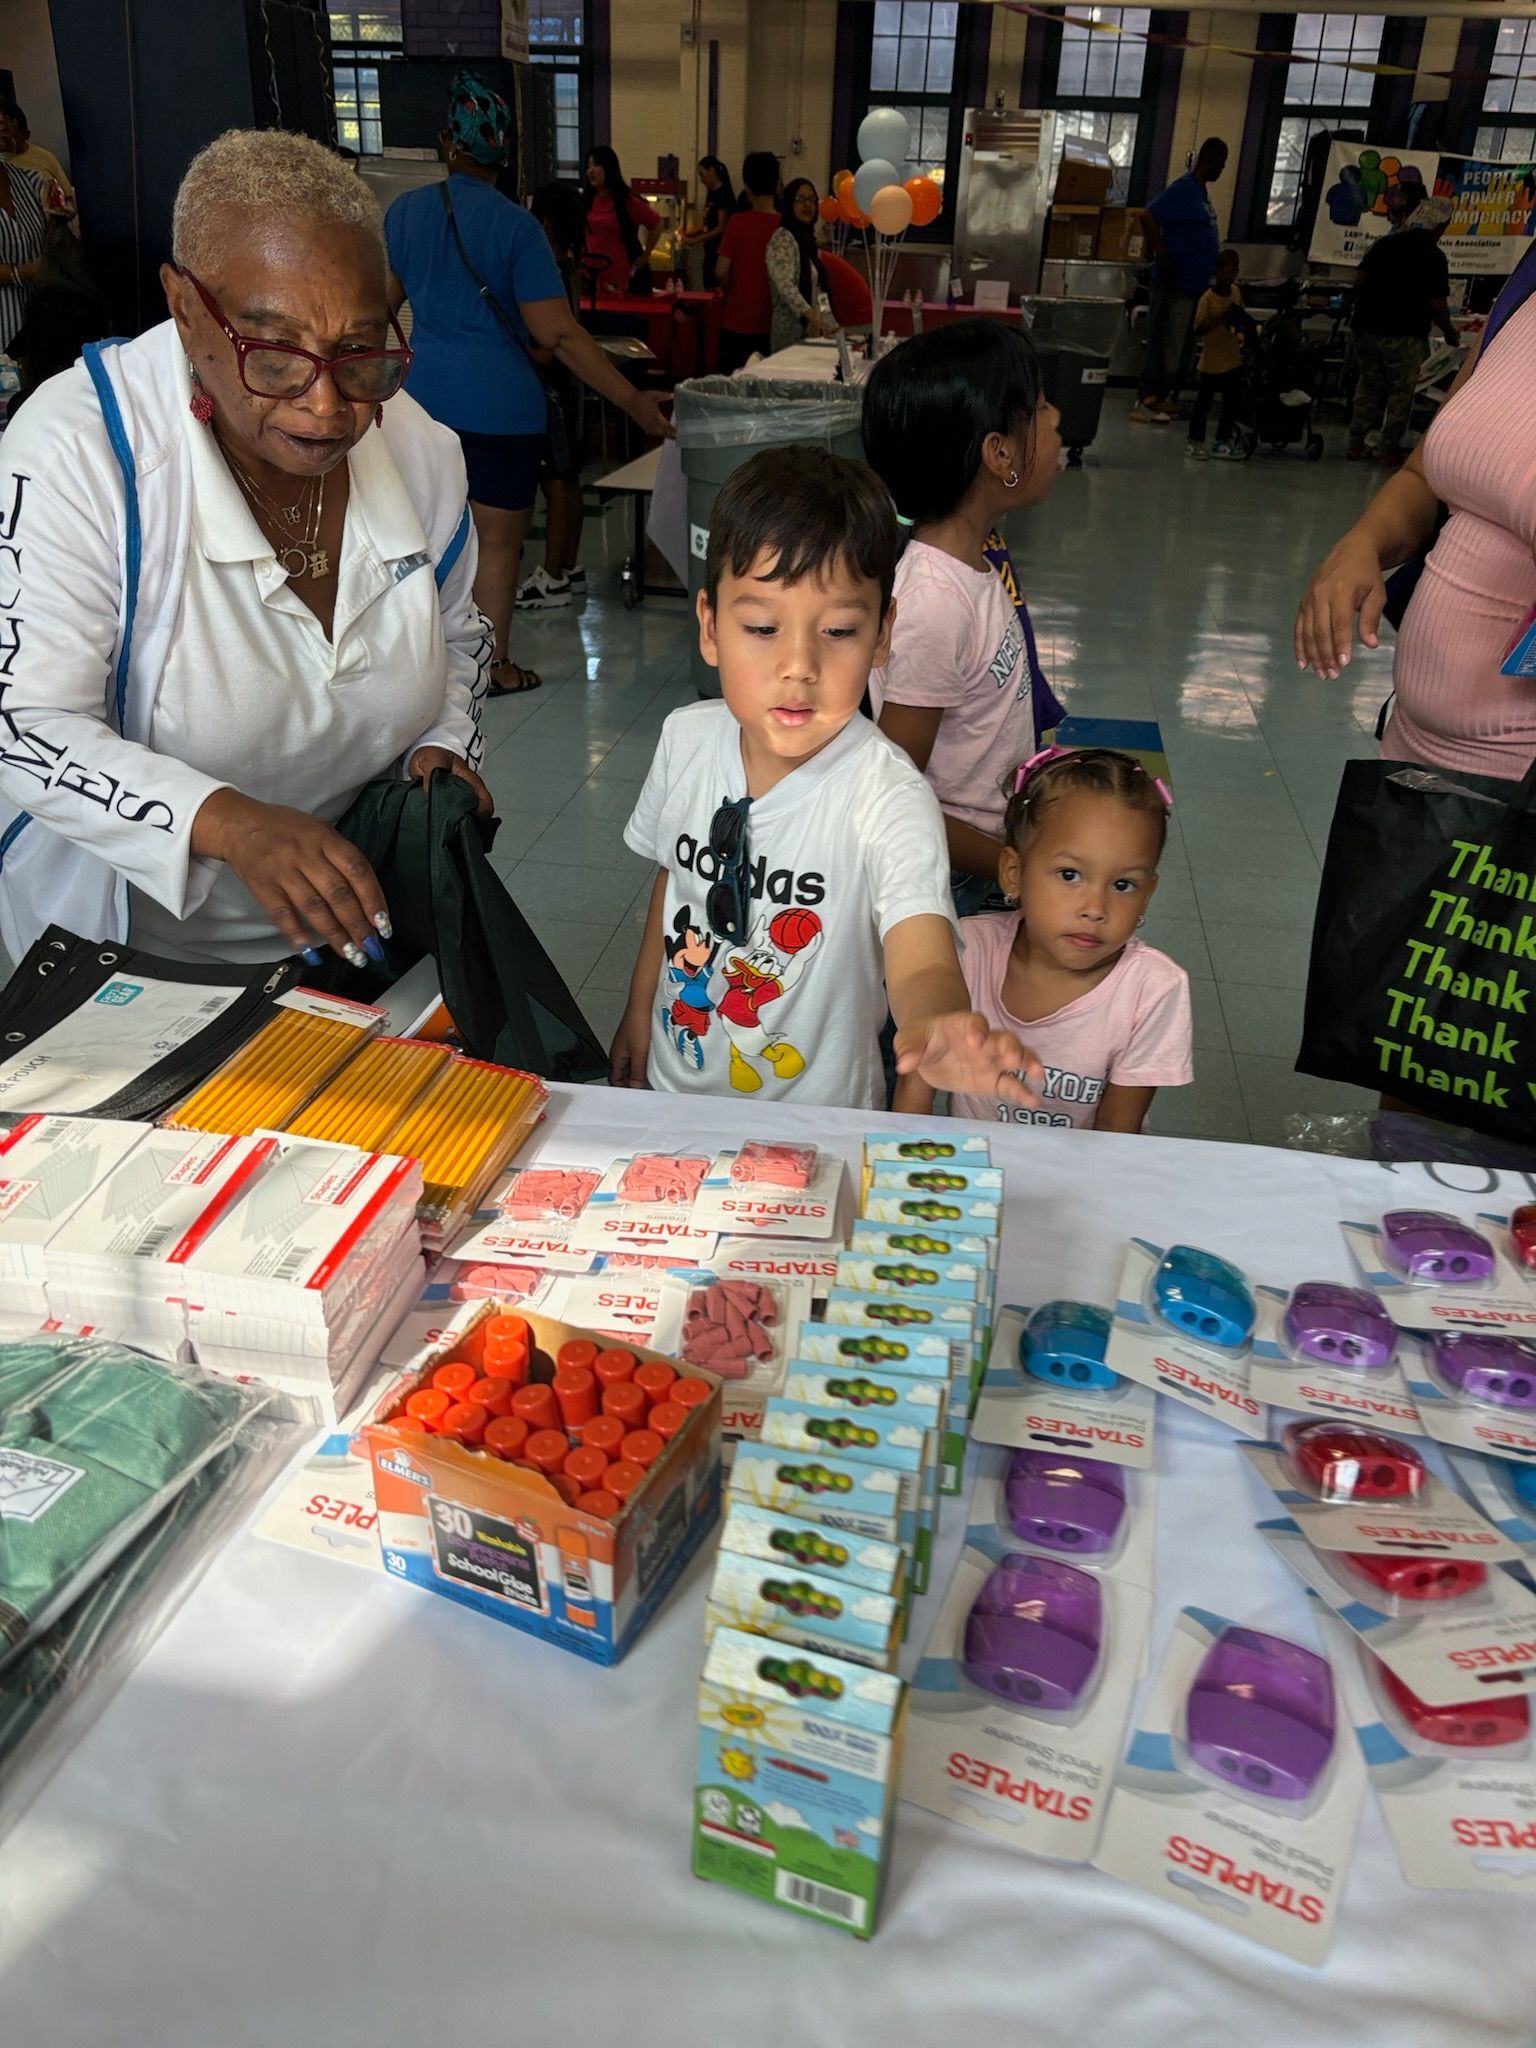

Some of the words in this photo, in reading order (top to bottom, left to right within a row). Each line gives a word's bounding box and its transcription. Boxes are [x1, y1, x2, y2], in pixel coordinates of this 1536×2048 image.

[1463, 171, 1518, 185] PEOPLE
[1460, 190, 1516, 205] POWER
[1451, 210, 1531, 225] MOCRACY
[1402, 938, 1530, 1014] Thank
[1385, 988, 1519, 1064] Thank
[13, 1054, 52, 1083] POUCH
[1043, 1066, 1104, 1104] YOR
[1373, 1036, 1510, 1108] Thank
[720, 1199, 827, 1218] STAPLES
[728, 1259, 838, 1278] STAPLES
[1154, 1357, 1259, 1415] STAPLES
[1299, 1386, 1420, 1421] STAPLES
[1026, 1415, 1145, 1449] STAPLES
[435, 1504, 473, 1540] 30
[1358, 1524, 1498, 1545] STAPLES
[387, 1551, 406, 1571] 30
[447, 1552, 498, 1582] School
[499, 1571, 534, 1594] Glue
[1054, 1750, 1103, 1776] Pencil
[946, 1751, 1094, 1823] STAPLES
[1200, 1807, 1285, 1853] Sharpener
[1284, 1845, 1337, 1877] Pencil
[1165, 1834, 1326, 1926] STAPLES
